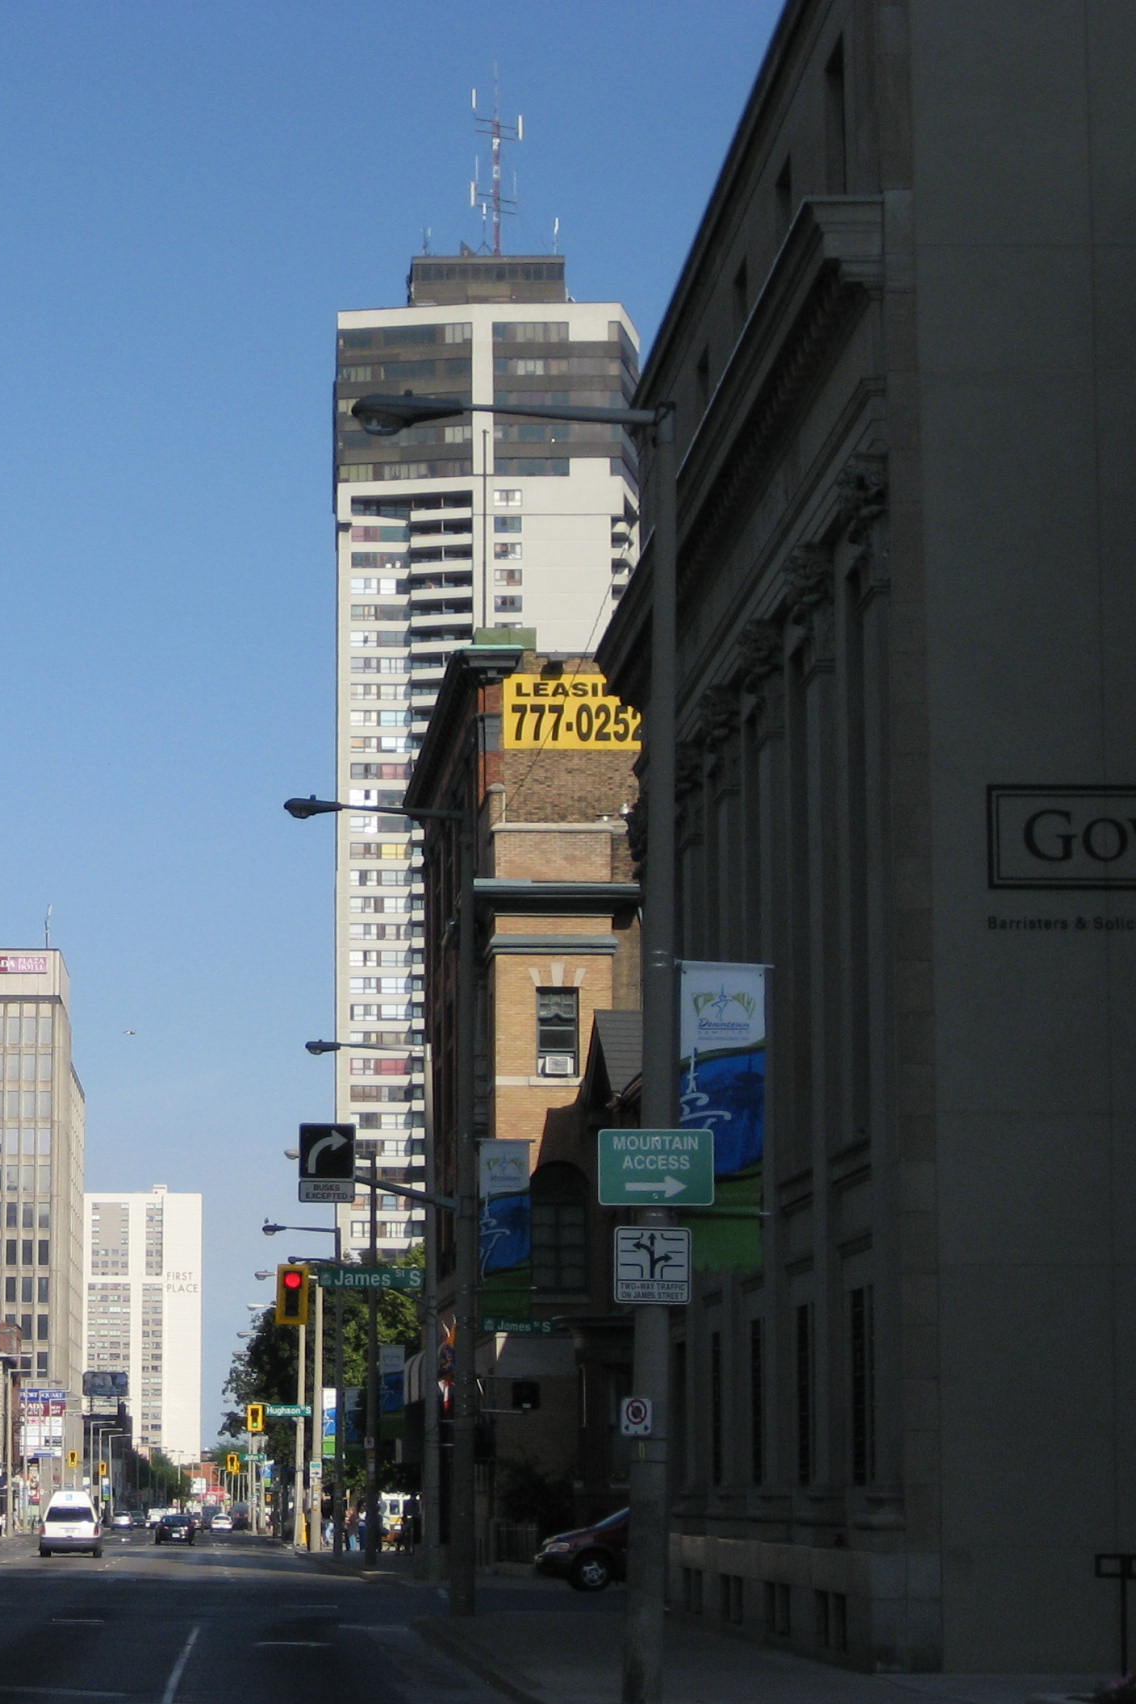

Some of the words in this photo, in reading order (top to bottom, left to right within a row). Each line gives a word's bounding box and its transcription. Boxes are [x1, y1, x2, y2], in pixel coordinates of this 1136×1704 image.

[988, 916, 1068, 930] Barristers
[1075, 916, 1086, 930] &
[612, 1136, 699, 1150] MOUNTAIN
[622, 1155, 691, 1170] ACCESS
[305, 1192, 348, 1200] EXCEPTED
[166, 1271, 192, 1280] FIRST
[334, 1269, 391, 1287] James
[409, 1270, 422, 1287] S
[166, 1283, 199, 1293] PLACE
[497, 1320, 532, 1332] James
[542, 1320, 552, 1333] S
[266, 1406, 301, 1416] Hughson
[306, 1406, 312, 1414] S
